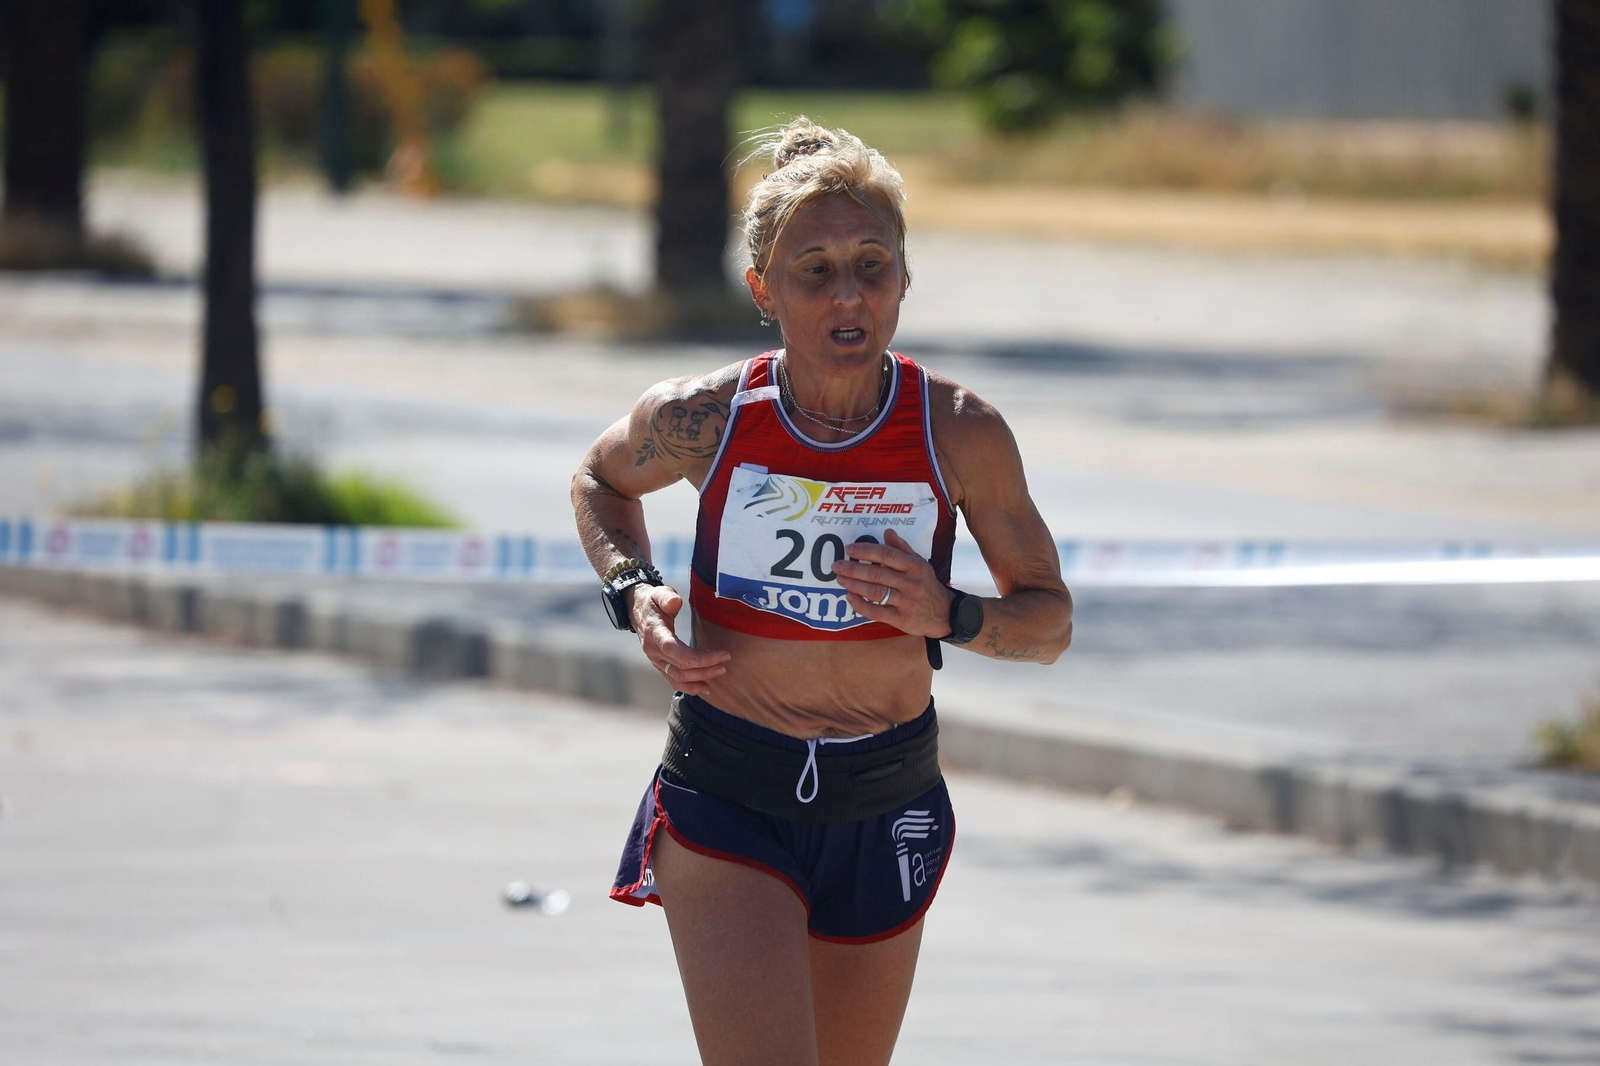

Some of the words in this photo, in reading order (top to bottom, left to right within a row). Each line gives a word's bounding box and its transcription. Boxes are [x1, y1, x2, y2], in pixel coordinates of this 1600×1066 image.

[825, 487, 887, 502] RFEA
[817, 503, 913, 514] ATLETISMO
[810, 515, 854, 526] RUTA
[856, 517, 917, 528] RUNNING
[759, 586, 864, 623] Jom
